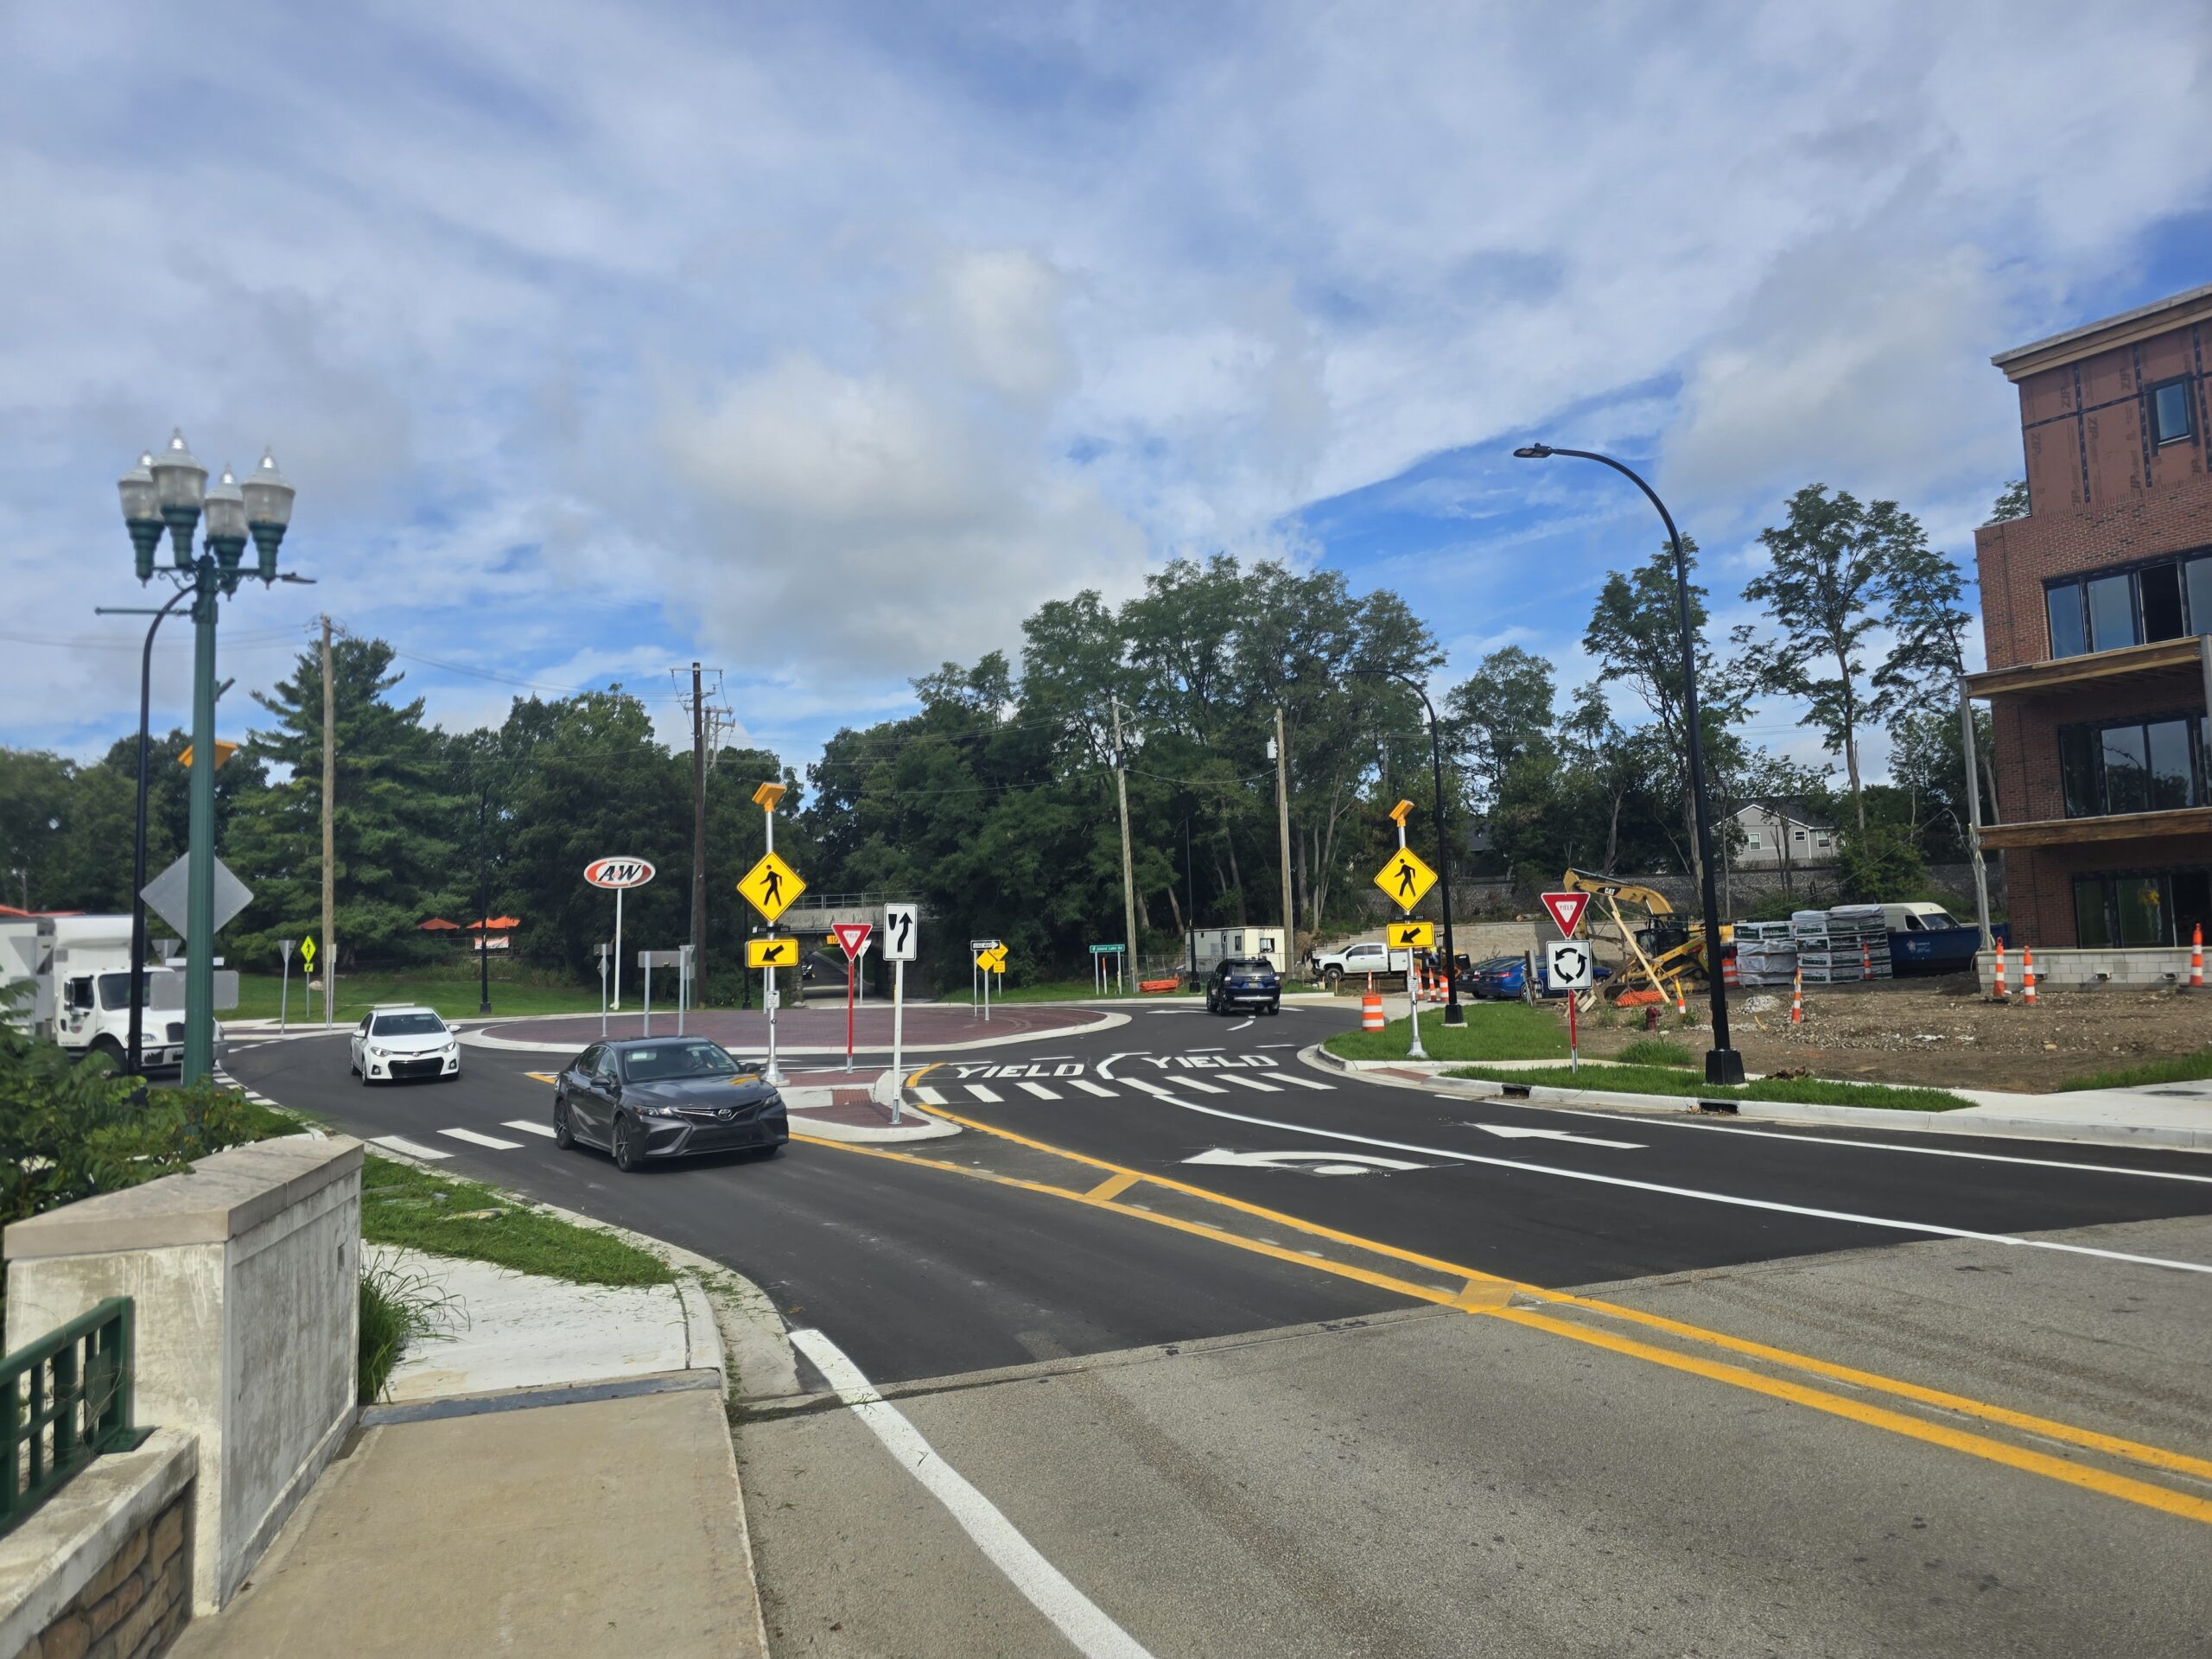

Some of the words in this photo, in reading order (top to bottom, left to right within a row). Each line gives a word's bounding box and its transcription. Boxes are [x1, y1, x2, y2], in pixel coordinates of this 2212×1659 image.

[1605, 887, 1616, 896] CAT
[1141, 1055, 1281, 1069] YIELD
[956, 1064, 1085, 1079] YIELD
